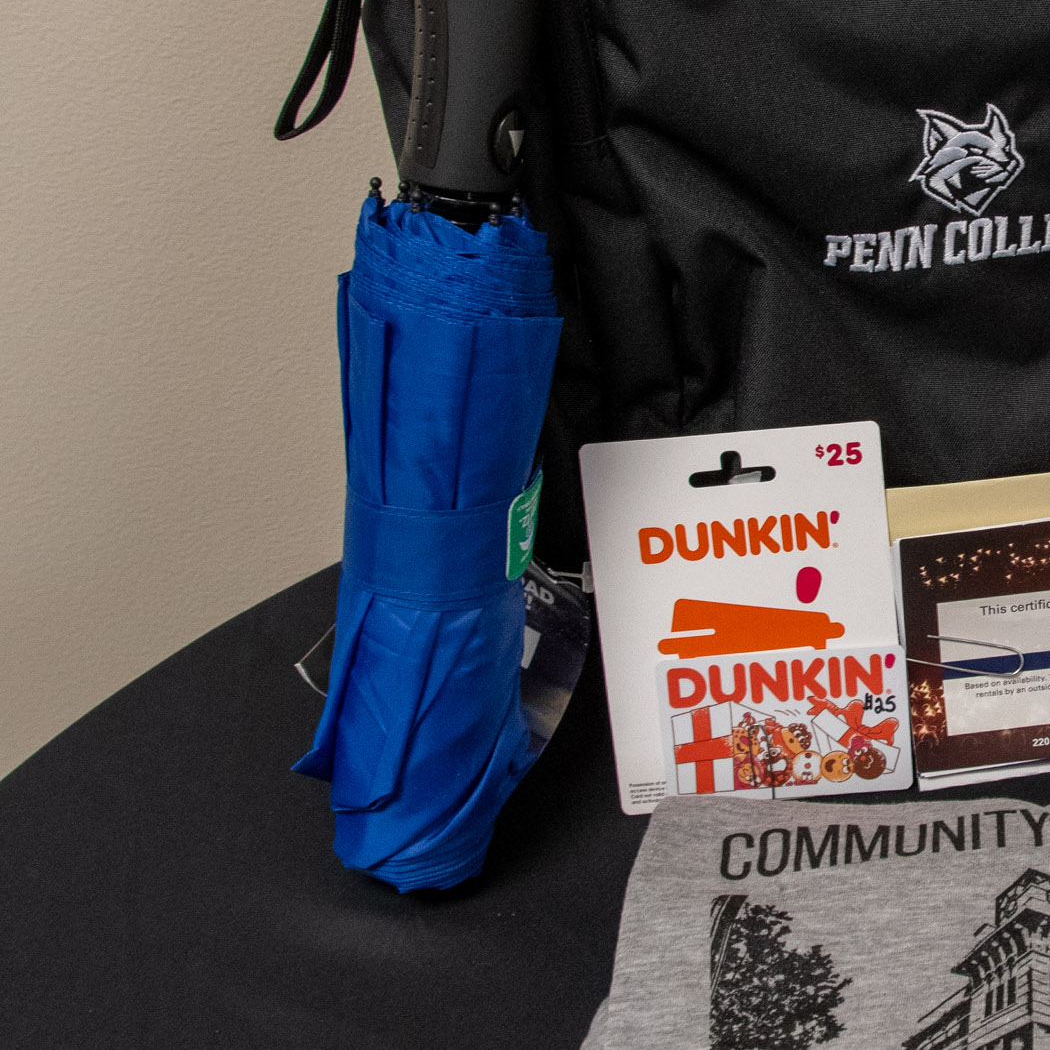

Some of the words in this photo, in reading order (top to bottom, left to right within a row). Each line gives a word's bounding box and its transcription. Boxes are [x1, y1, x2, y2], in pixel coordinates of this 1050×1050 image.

[823, 224, 938, 273] PENN
[815, 442, 862, 466] $25
[638, 510, 840, 564] DUNKIN'
[980, 605, 1007, 616] This
[667, 653, 895, 709] DUNKIN'
[965, 681, 988, 690] Based
[1003, 674, 1047, 685] availability.
[862, 693, 896, 713] $25
[976, 689, 1003, 698] rentals
[1005, 688, 1014, 696] by
[1032, 738, 1050, 747] 220
